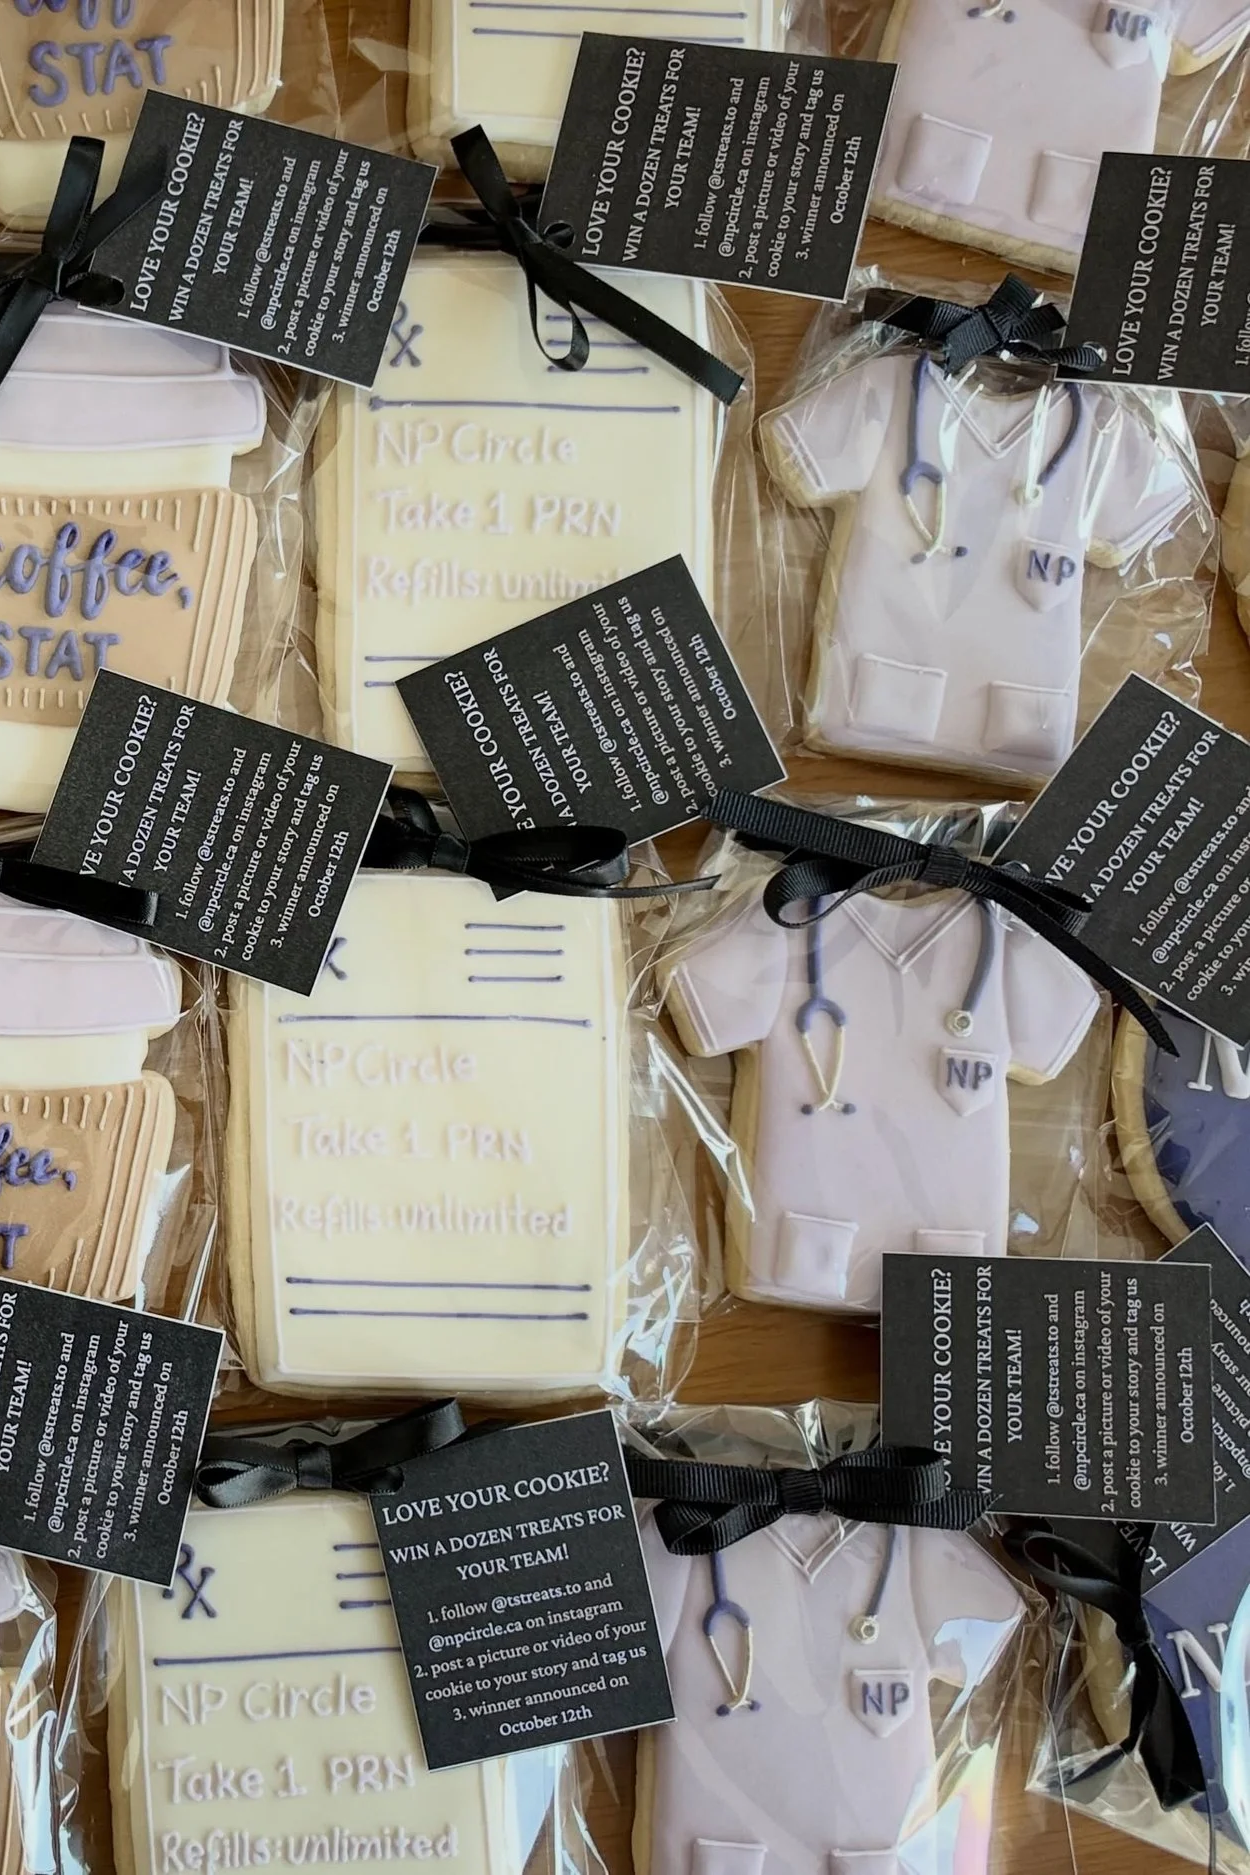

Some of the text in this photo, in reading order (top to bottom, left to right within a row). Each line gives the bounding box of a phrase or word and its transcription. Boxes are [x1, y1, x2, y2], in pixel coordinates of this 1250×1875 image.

[29, 35, 173, 107] STAT
[580, 46, 646, 256] LOVE YOUR COOKIE?
[692, 76, 745, 249] 1. follow @tstreats.to and
[717, 75, 771, 257] @npcircle.ca on instagram
[128, 111, 206, 312] LOVE YOUR COOKIE?
[365, 228, 401, 313] October 12th
[1111, 165, 1172, 376] LOVE YOUR COOKIE?
[373, 420, 578, 468] NP Circle
[372, 487, 476, 536] Take
[530, 493, 622, 538] PRN
[1026, 550, 1076, 586] NP
[687, 632, 737, 720] October 12th
[443, 669, 527, 819] YOUR COOKIE?
[78, 693, 158, 875] VE YOUR COOKIE?
[1043, 710, 1181, 881] VE YOUR COOKIE?
[307, 860, 338, 918] October
[327, 830, 350, 861] 12th
[284, 1038, 478, 1087] NP Circle
[946, 1056, 993, 1090] NP
[286, 1114, 388, 1162] Take
[445, 1120, 533, 1164] PRN
[929, 1267, 952, 1366] COOKIE?
[932, 1369, 952, 1436] YOUR
[1176, 1346, 1195, 1444] October 12th
[46, 1333, 101, 1533] @npcircle.ca on instagram
[380, 1460, 610, 1526] LOVE YOUR COOKIE?
[388, 1503, 626, 1564] WIN A DOZEN TREATS FOR
[455, 1541, 569, 1581] YOUR TEAM!
[426, 1571, 614, 1624] 1. follow @tstreats.to and
[427, 1599, 624, 1653] @npcircle.ca on instagram
[412, 1619, 647, 1679] 2. post a picture or video of your
[424, 1645, 647, 1701] cookie to your story and tag us
[159, 1673, 377, 1727] NP Circle
[451, 1674, 630, 1721] 3. winner announced on
[498, 1703, 593, 1736] October 12th
[861, 1681, 910, 1716] NP
[156, 1755, 265, 1804] Take
[328, 1753, 416, 1796] PRN
